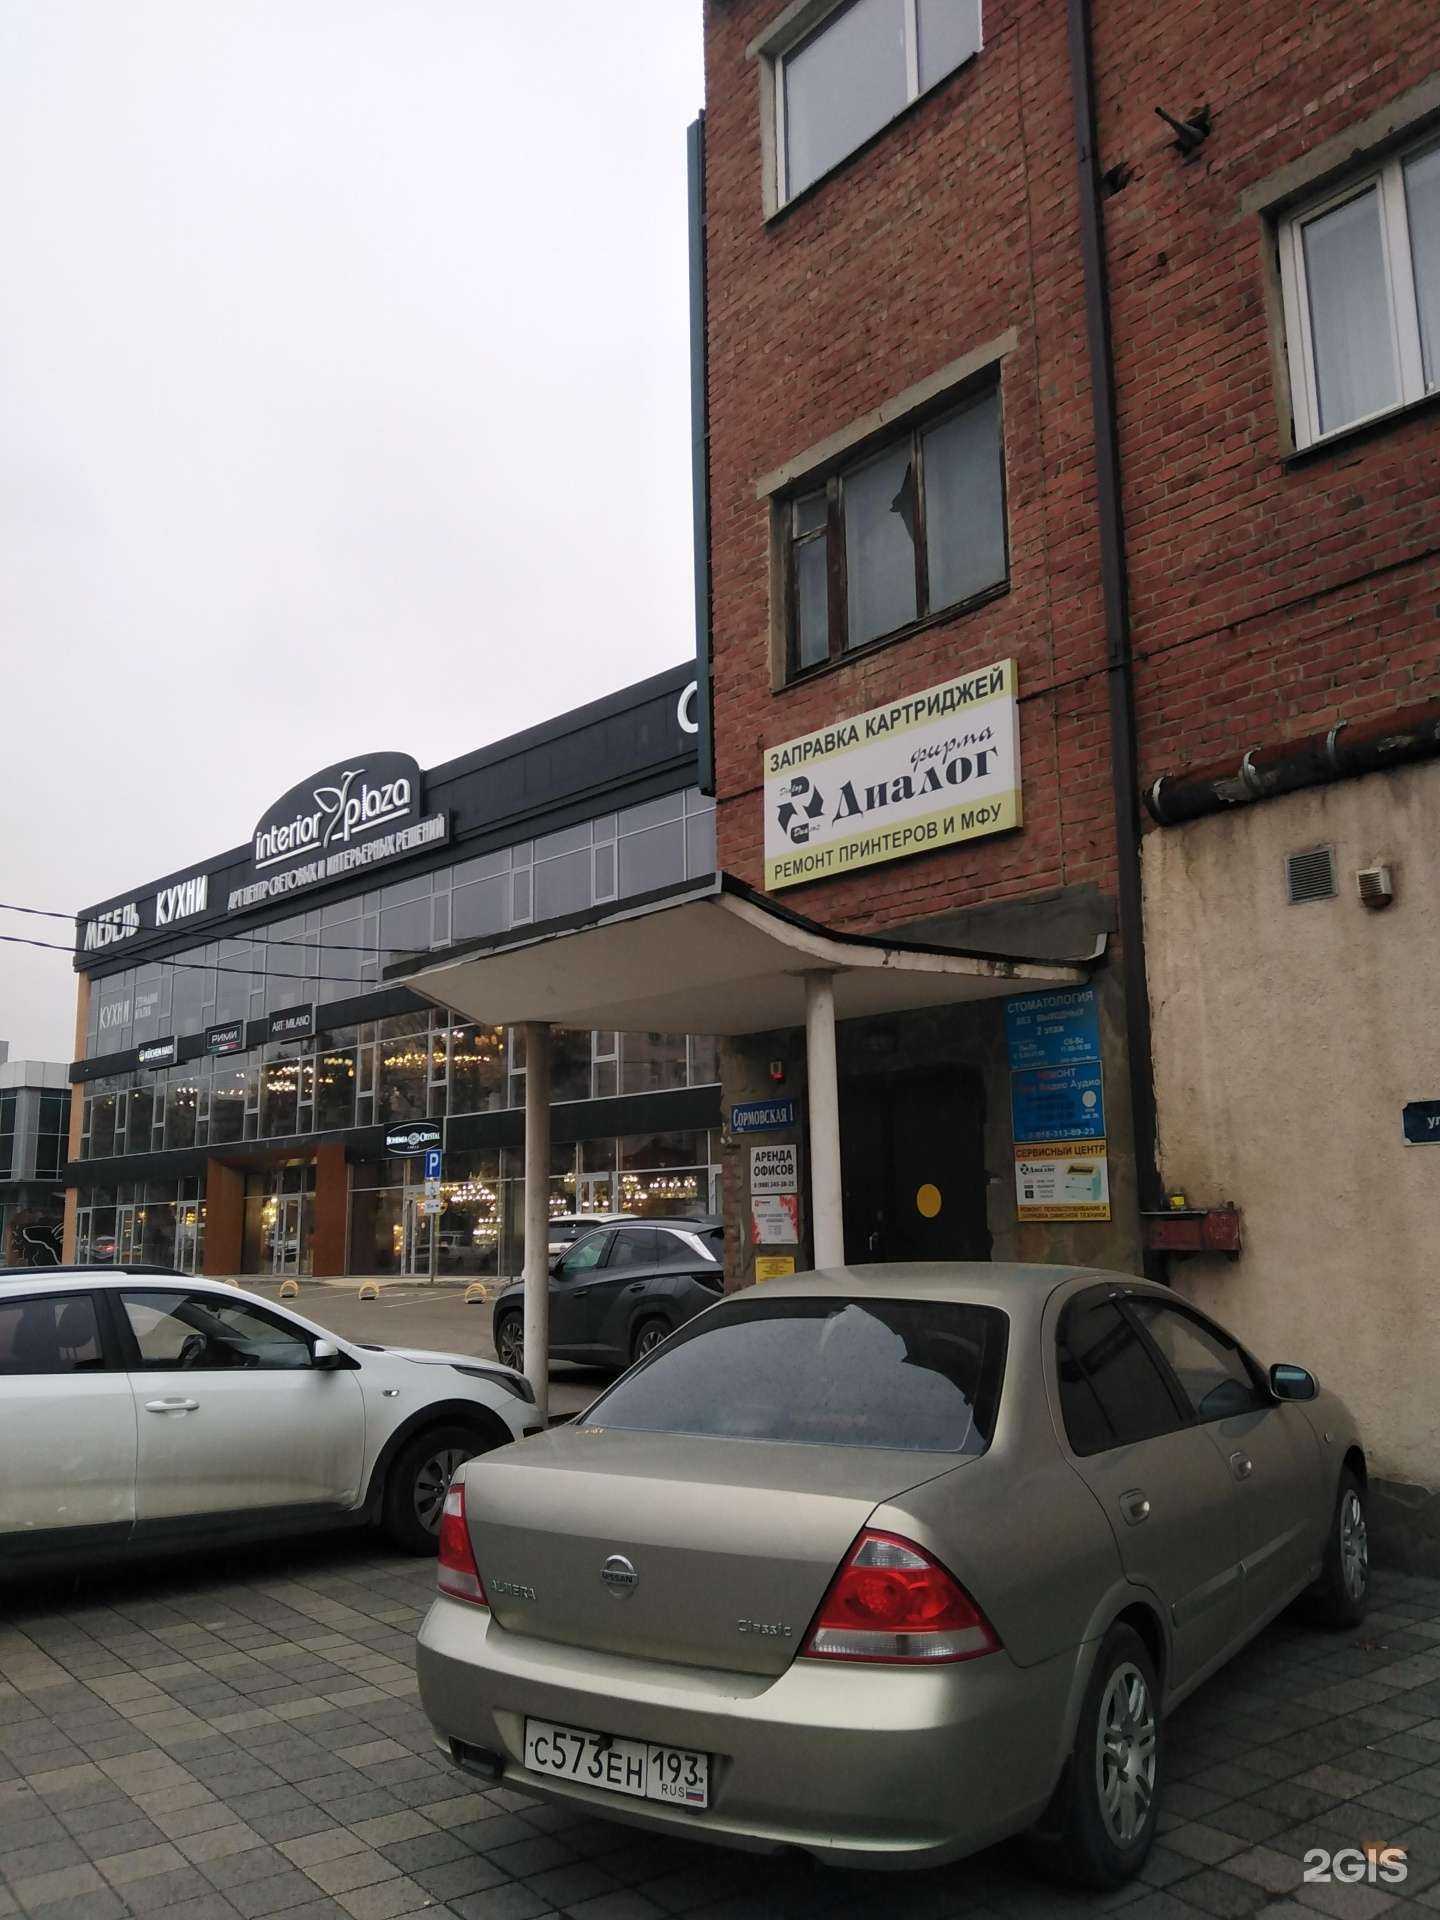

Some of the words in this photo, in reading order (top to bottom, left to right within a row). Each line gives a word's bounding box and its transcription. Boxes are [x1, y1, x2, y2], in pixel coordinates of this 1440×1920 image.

[770, 724, 859, 773] ЗАПРАВКА
[865, 668, 1004, 739] КАРТРИДЖЕЙ
[910, 725, 995, 772] фирма
[256, 812, 323, 860] interior
[344, 779, 411, 841] plaza
[774, 850, 834, 880] РЕМОНТ
[839, 821, 938, 863] ПРИНТЕРОВ
[943, 816, 955, 835] И
[961, 802, 1002, 831] МФУ
[156, 875, 208, 927] КУХНИ
[84, 902, 140, 951] МЕБЕЛЬ
[1008, 990, 1094, 1014] СТОМАТОЛОГИЯ
[430, 1153, 439, 1175] P
[755, 1150, 792, 1163] АРЕНДА
[1016, 1147, 1072, 1158] СЕРВИСНЫЙ
[1074, 1145, 1105, 1157] ЦЕНТР
[754, 1164, 794, 1176] ОФИСОВ
[652, 1751, 698, 1786] 193
[661, 1784, 685, 1798] RUS
